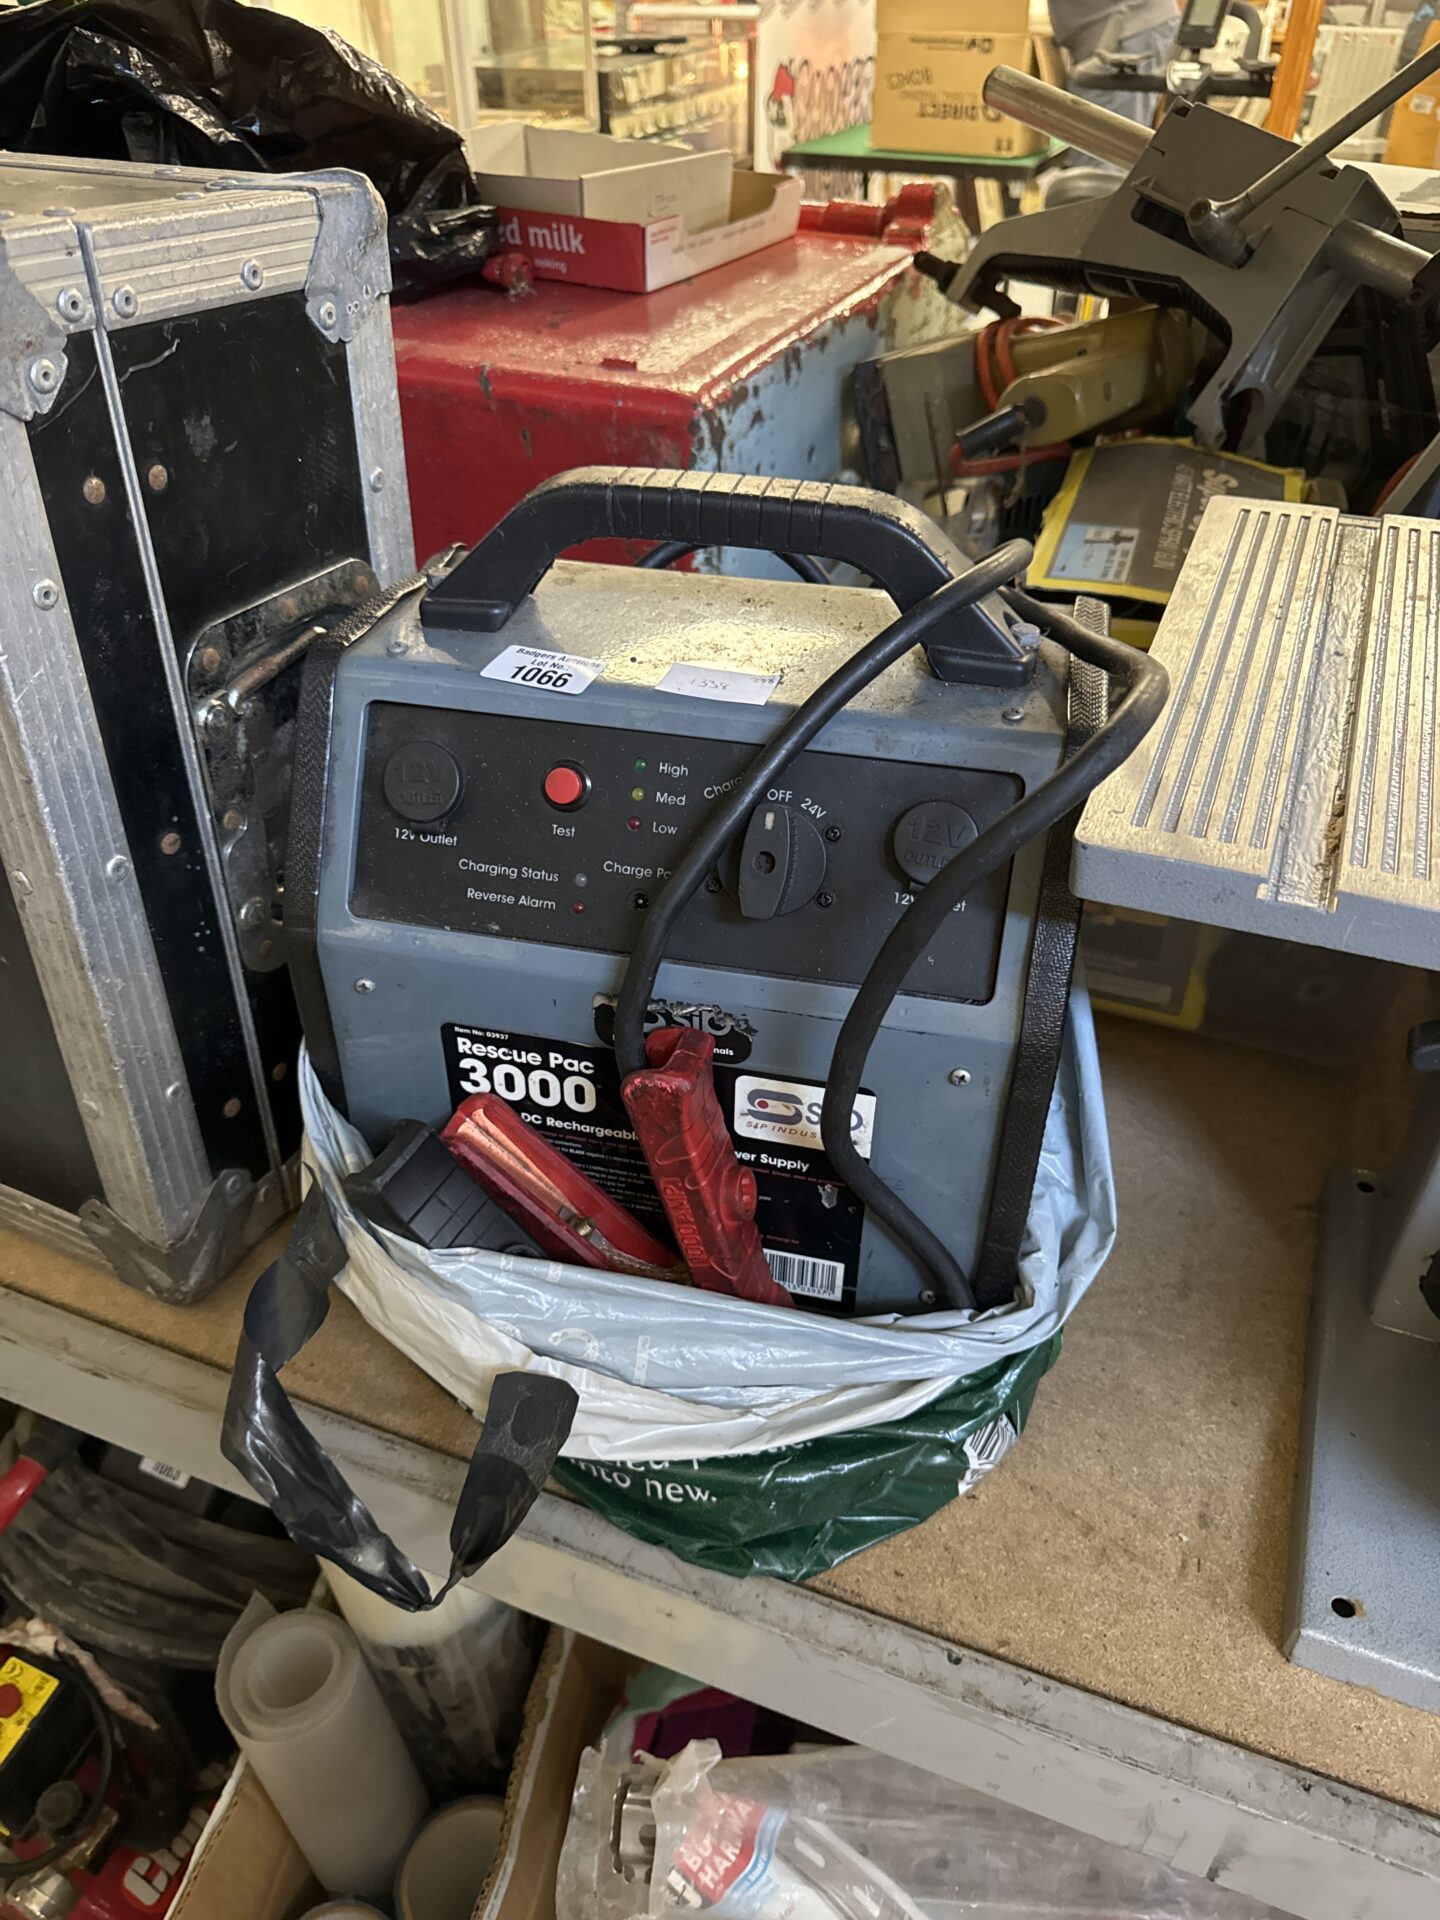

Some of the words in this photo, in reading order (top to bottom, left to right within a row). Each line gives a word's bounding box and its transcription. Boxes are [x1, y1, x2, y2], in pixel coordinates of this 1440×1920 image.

[527, 221, 586, 255] milk
[516, 648, 557, 661] Badgers
[530, 659, 548, 667] Lot
[510, 665, 573, 688] 1066
[658, 761, 689, 778] High
[655, 791, 687, 806] Med
[766, 788, 793, 802] OFF
[800, 798, 827, 819] 24V
[552, 823, 576, 838] Test
[652, 821, 678, 835] Low
[418, 831, 458, 847] Outlet
[458, 858, 518, 879] Charging
[521, 867, 559, 883] Status
[603, 860, 654, 879] Charge
[466, 887, 515, 905] Reverse
[518, 895, 556, 910] Alarm
[454, 1026, 471, 1035] Item
[472, 1029, 485, 1037] No:
[486, 1032, 509, 1041] 03937
[456, 1036, 543, 1067] Rescue
[548, 1051, 595, 1075] Pac
[458, 1057, 597, 1113] 3000
[521, 1112, 543, 1125] DC
[546, 1116, 640, 1142] Rechargeabl
[771, 1125, 822, 1139] INDUS
[568, 1147, 585, 1155] BLACK
[760, 1153, 810, 1173] Supply
[645, 1478, 718, 1502] new.
